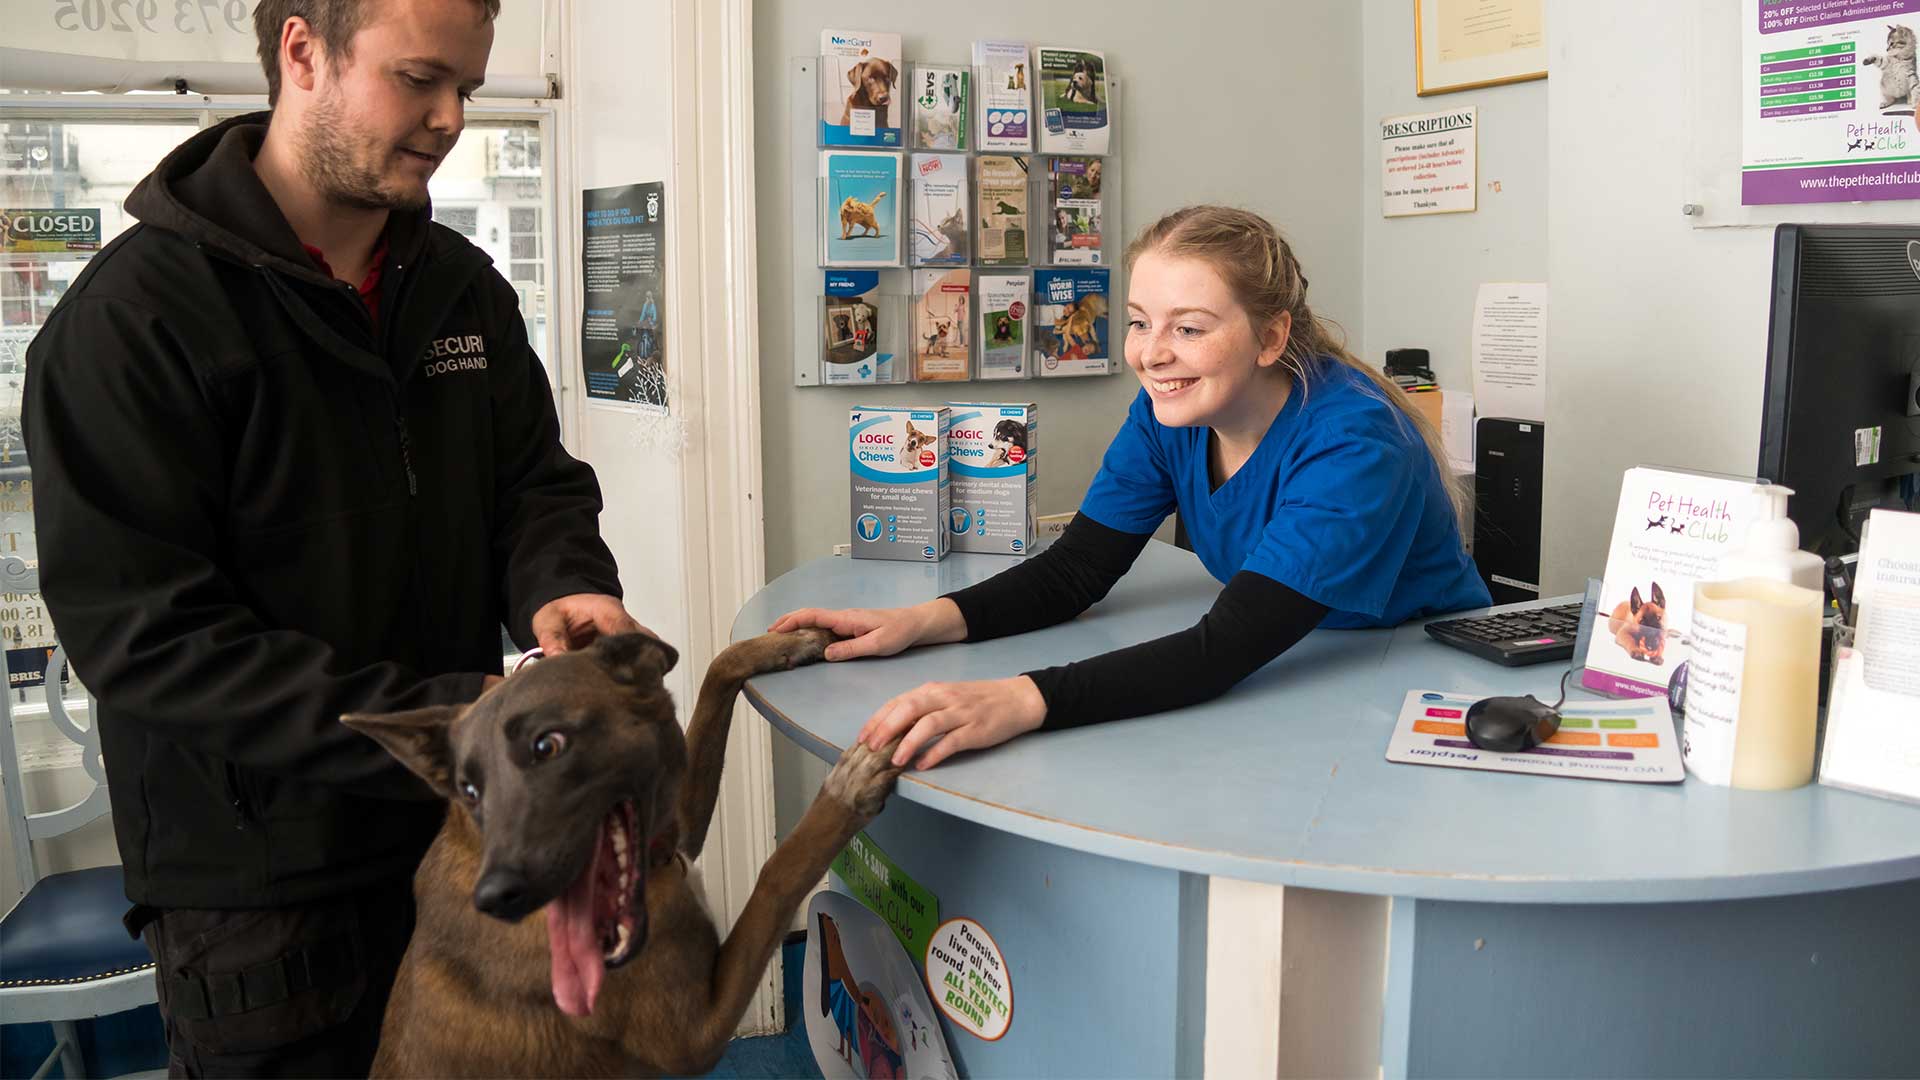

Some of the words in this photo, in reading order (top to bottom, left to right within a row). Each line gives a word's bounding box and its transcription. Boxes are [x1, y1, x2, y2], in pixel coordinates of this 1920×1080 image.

[1763, 10, 1779, 19] 20%
[1781, 7, 1794, 16] OFF
[1795, 3, 1821, 14] Selected
[1763, 19, 1783, 29] 100%
[1784, 16, 1798, 25] OFF
[1799, 13, 1818, 24] Direct
[1820, 10, 1841, 21] Claims
[1843, 4, 1891, 17] Administration
[1892, 1, 1904, 9] Fee
[926, 72, 935, 97] EVS
[1383, 112, 1472, 137] PRESCRIPTIONS
[1847, 123, 1864, 137] Pet
[1867, 120, 1906, 135] Health
[1877, 136, 1906, 150] Club
[13, 215, 95, 232] CLOSED
[1049, 281, 1072, 290] WORM
[1051, 290, 1073, 301] WISE
[425, 359, 458, 377] DOG
[458, 357, 488, 370] HAND
[859, 434, 894, 444] LOGIC
[949, 430, 983, 439] LOGIC
[859, 451, 895, 462] Chews
[949, 446, 984, 457] Chews
[855, 485, 889, 494] Veterinary
[994, 488, 1010, 496] dogs
[1648, 491, 1674, 512] Pet
[1678, 496, 1732, 521] Health
[1687, 520, 1729, 544] Club
[10, 671, 44, 682] BRIS.
[1410, 748, 1478, 761] Petplan
[870, 853, 889, 886] SAVE
[890, 879, 908, 902] with
[910, 895, 924, 916] our
[960, 924, 999, 971] Parasites
[948, 934, 968, 957] live
[970, 954, 983, 971] all
[983, 968, 1002, 992] year
[931, 946, 966, 977] round,
[968, 969, 1008, 1017] PROTECT
[944, 970, 964, 992] ALL
[969, 986, 992, 1018] YEAR
[945, 990, 984, 1028] ROUND
